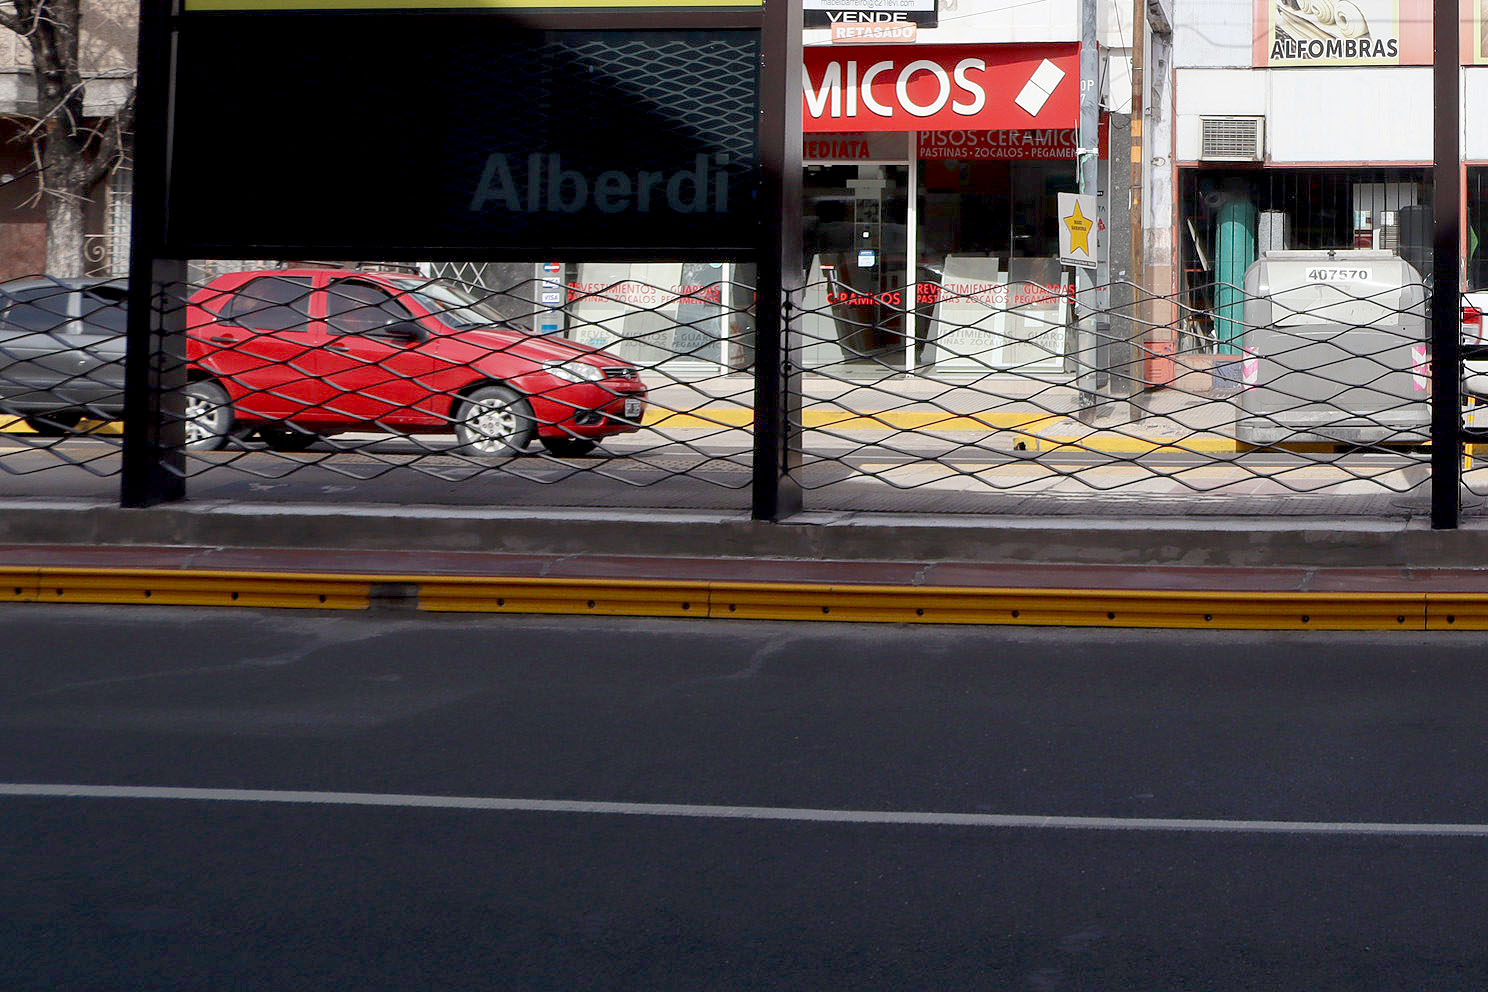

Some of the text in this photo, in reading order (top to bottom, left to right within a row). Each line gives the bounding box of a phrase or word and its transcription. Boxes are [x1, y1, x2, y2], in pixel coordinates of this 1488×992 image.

[825, 11, 908, 23] VENDE
[836, 27, 913, 38] RETASADO
[1270, 37, 1398, 60] ALFOMBRAS
[802, 58, 986, 118] MICOS
[920, 129, 977, 146] PISOS
[803, 140, 870, 159] EDIATA
[920, 147, 968, 158] PASTINAS
[974, 147, 1024, 158] ZOCALOS
[469, 152, 730, 214] Alberdi
[1308, 268, 1369, 281] 407570
